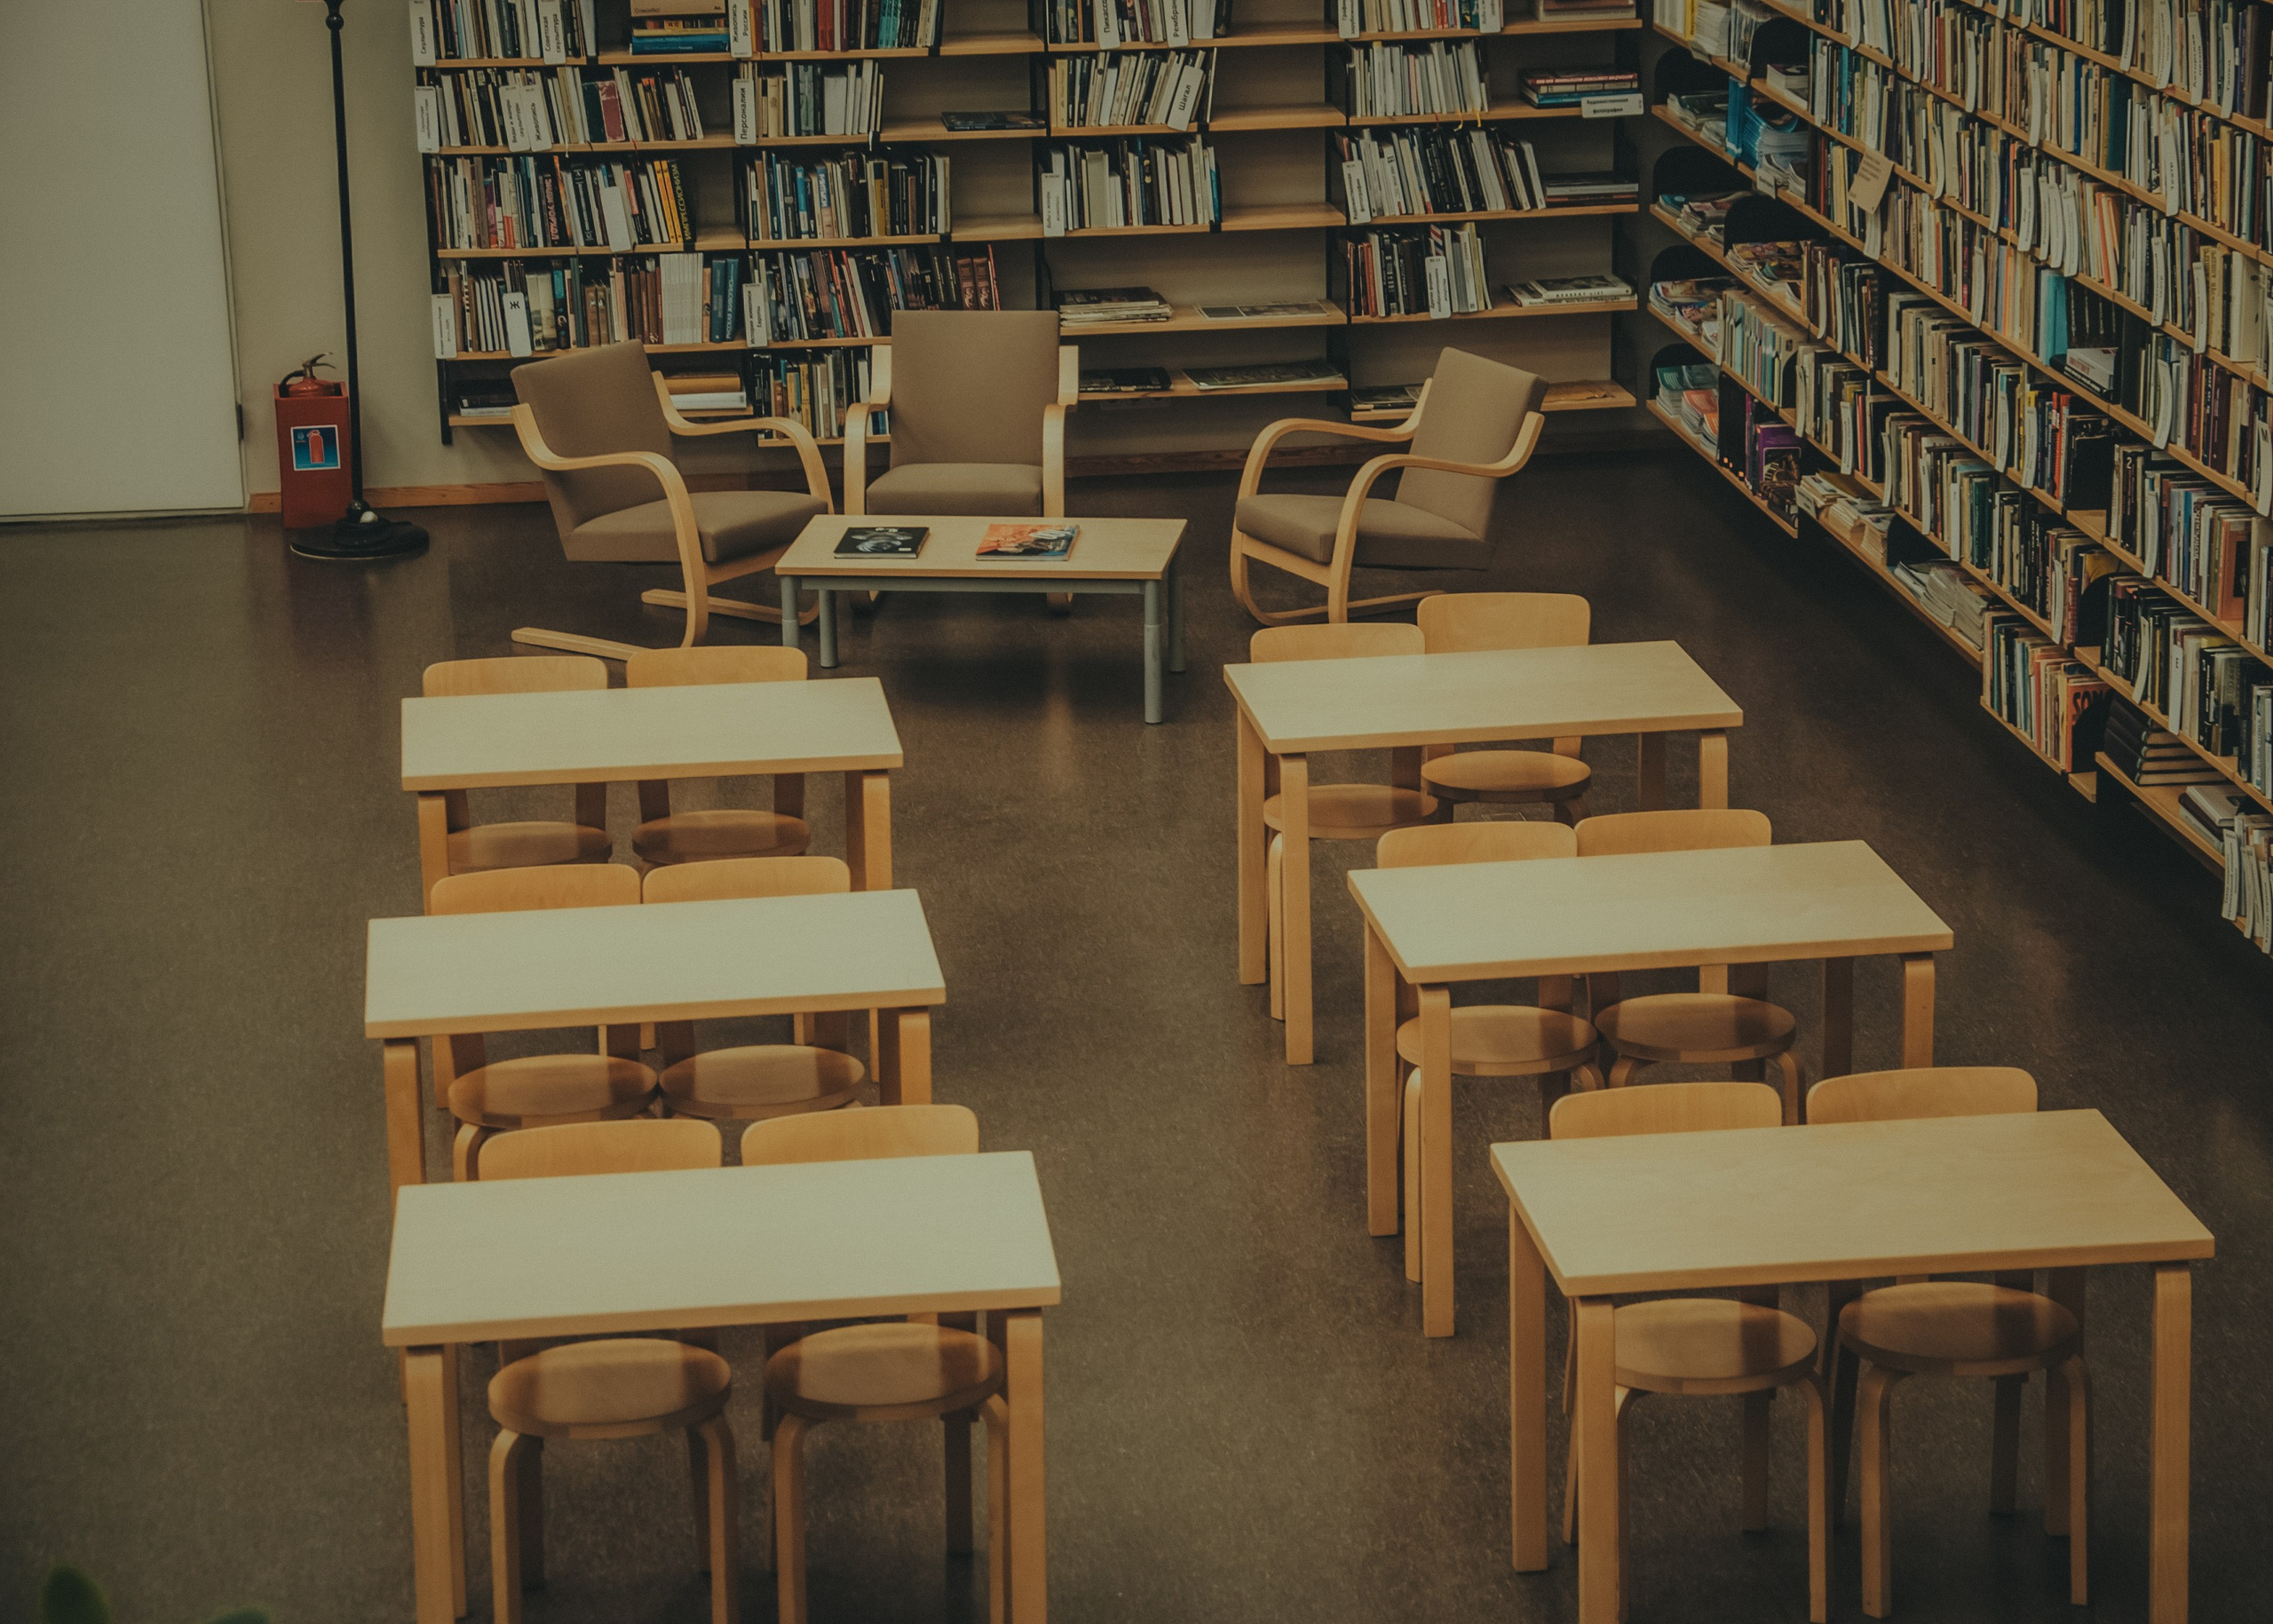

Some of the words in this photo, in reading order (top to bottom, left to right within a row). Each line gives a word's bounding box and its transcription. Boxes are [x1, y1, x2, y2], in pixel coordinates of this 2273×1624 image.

[418, 16, 427, 54] Скульптура
[543, 16, 551, 51] Советская
[552, 13, 561, 53] скульптура
[1178, 84, 1192, 111] Шагал
[530, 102, 542, 141] Живопись
[671, 162, 692, 242] ИМПРЕССИОНИЗМ
[510, 300, 520, 310] Ж
